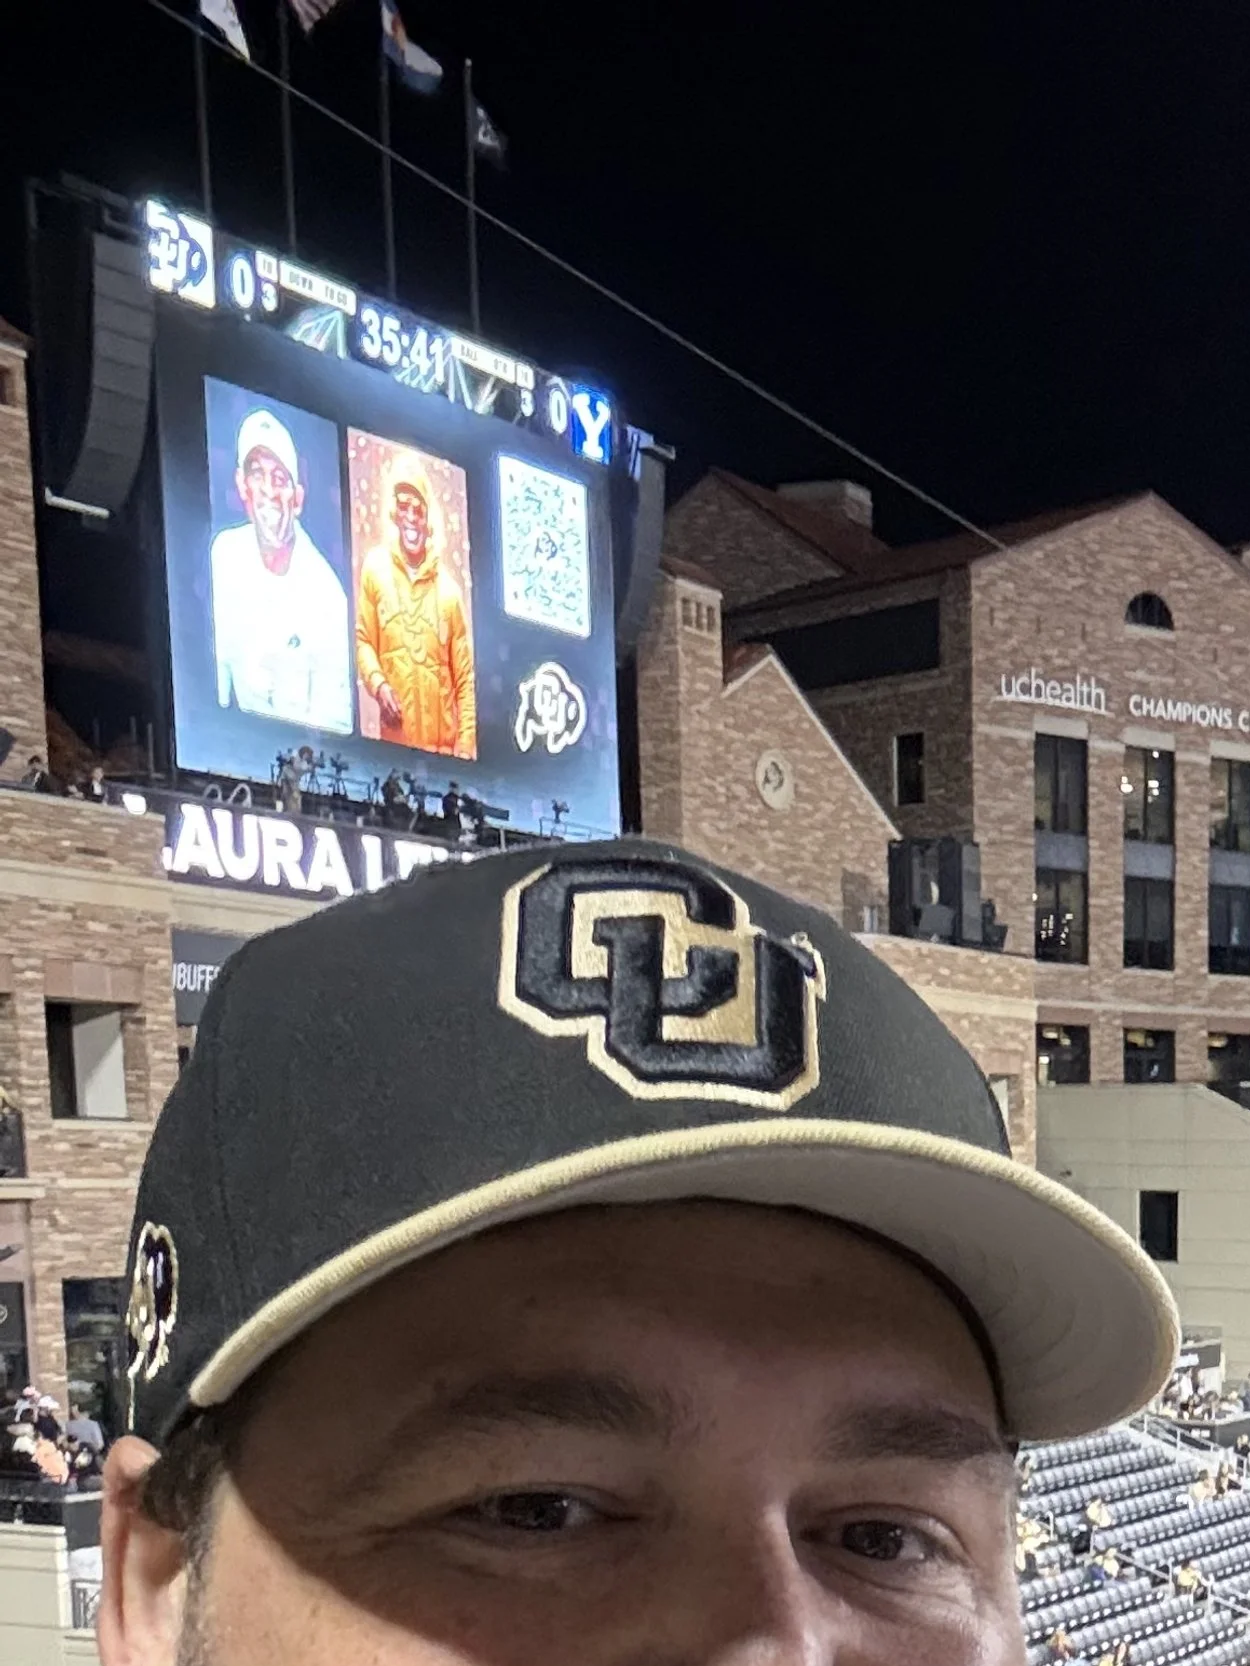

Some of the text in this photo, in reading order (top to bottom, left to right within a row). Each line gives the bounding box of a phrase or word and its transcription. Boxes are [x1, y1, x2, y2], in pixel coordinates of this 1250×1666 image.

[232, 257, 254, 308] 0
[549, 388, 568, 434] 0
[572, 393, 612, 459] Y
[996, 666, 1114, 717] uchealth
[1129, 694, 1233, 730] CHAMPIONS
[163, 803, 355, 897] AURA
